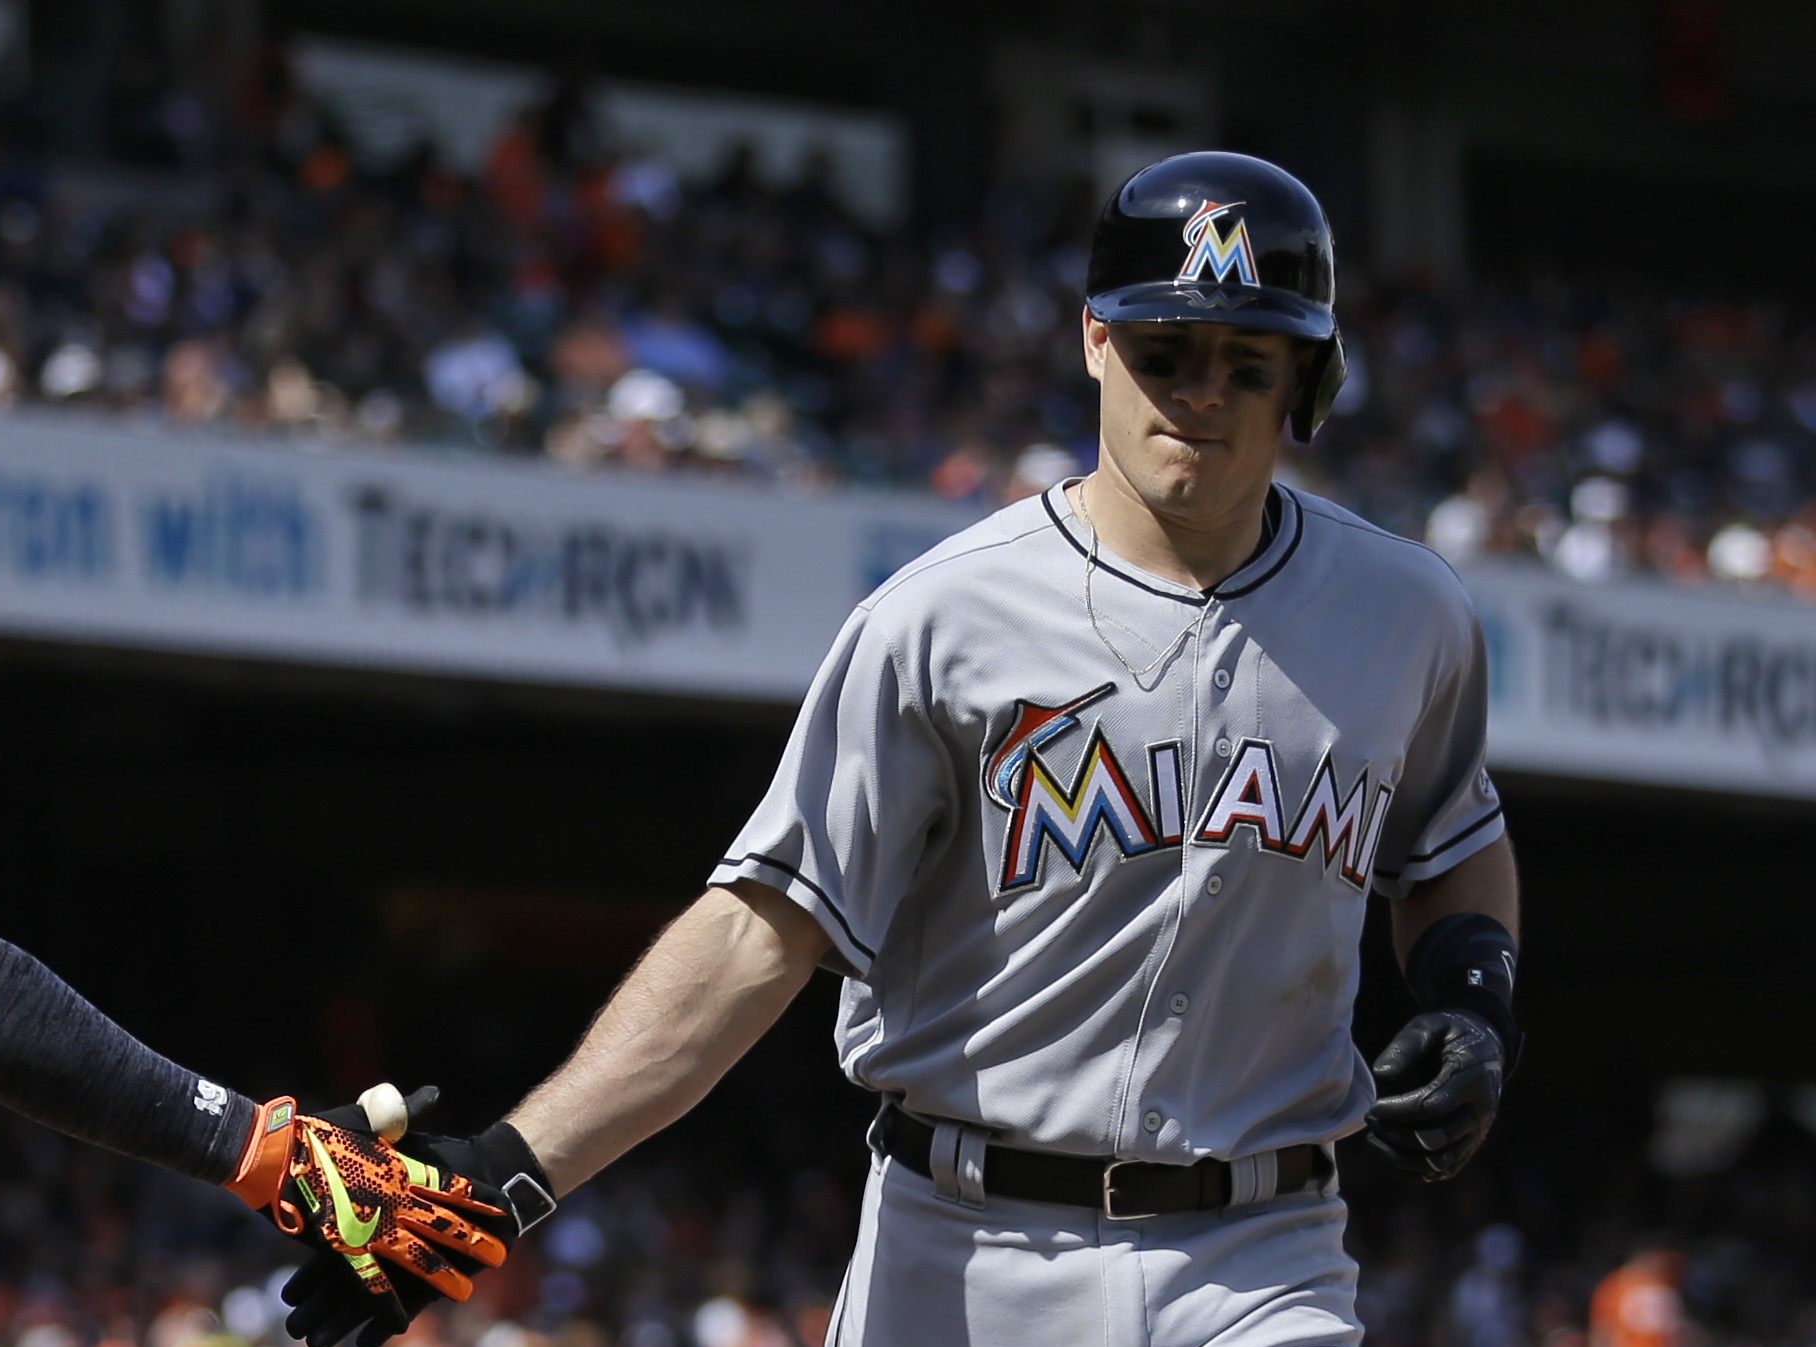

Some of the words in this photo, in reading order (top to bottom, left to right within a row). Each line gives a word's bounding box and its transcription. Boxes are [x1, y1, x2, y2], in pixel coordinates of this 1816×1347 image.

[148, 476, 312, 600] with
[347, 478, 756, 636] TECHRON
[993, 712, 1394, 899] MIAMI
[193, 1078, 228, 1116] 19
